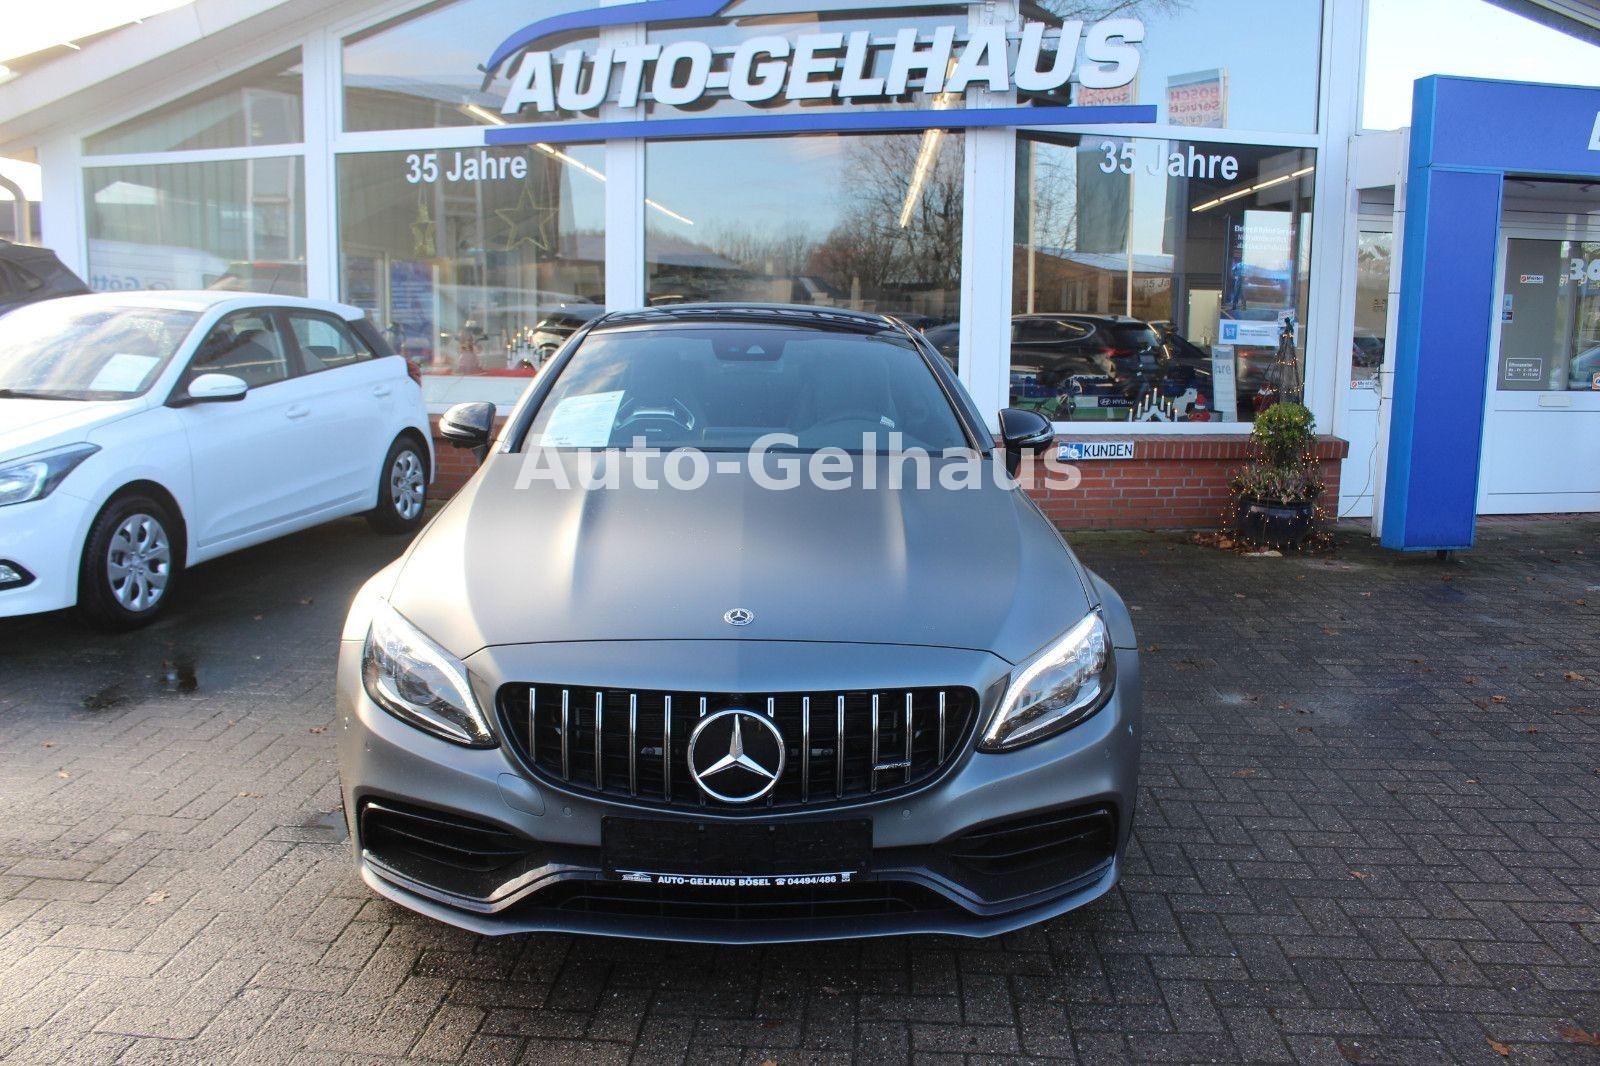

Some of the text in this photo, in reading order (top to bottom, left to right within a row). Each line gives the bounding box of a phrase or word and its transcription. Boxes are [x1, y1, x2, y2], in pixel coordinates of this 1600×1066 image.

[501, 18, 1145, 114] AUTO-GELHAUS
[406, 151, 528, 183] 35 Jahre
[1100, 141, 1239, 180] 35 Jahre
[1083, 444, 1133, 458] KUNDEN
[658, 876, 736, 887] AUTO-GELHAUS
[787, 875, 837, 886] 04494/486
